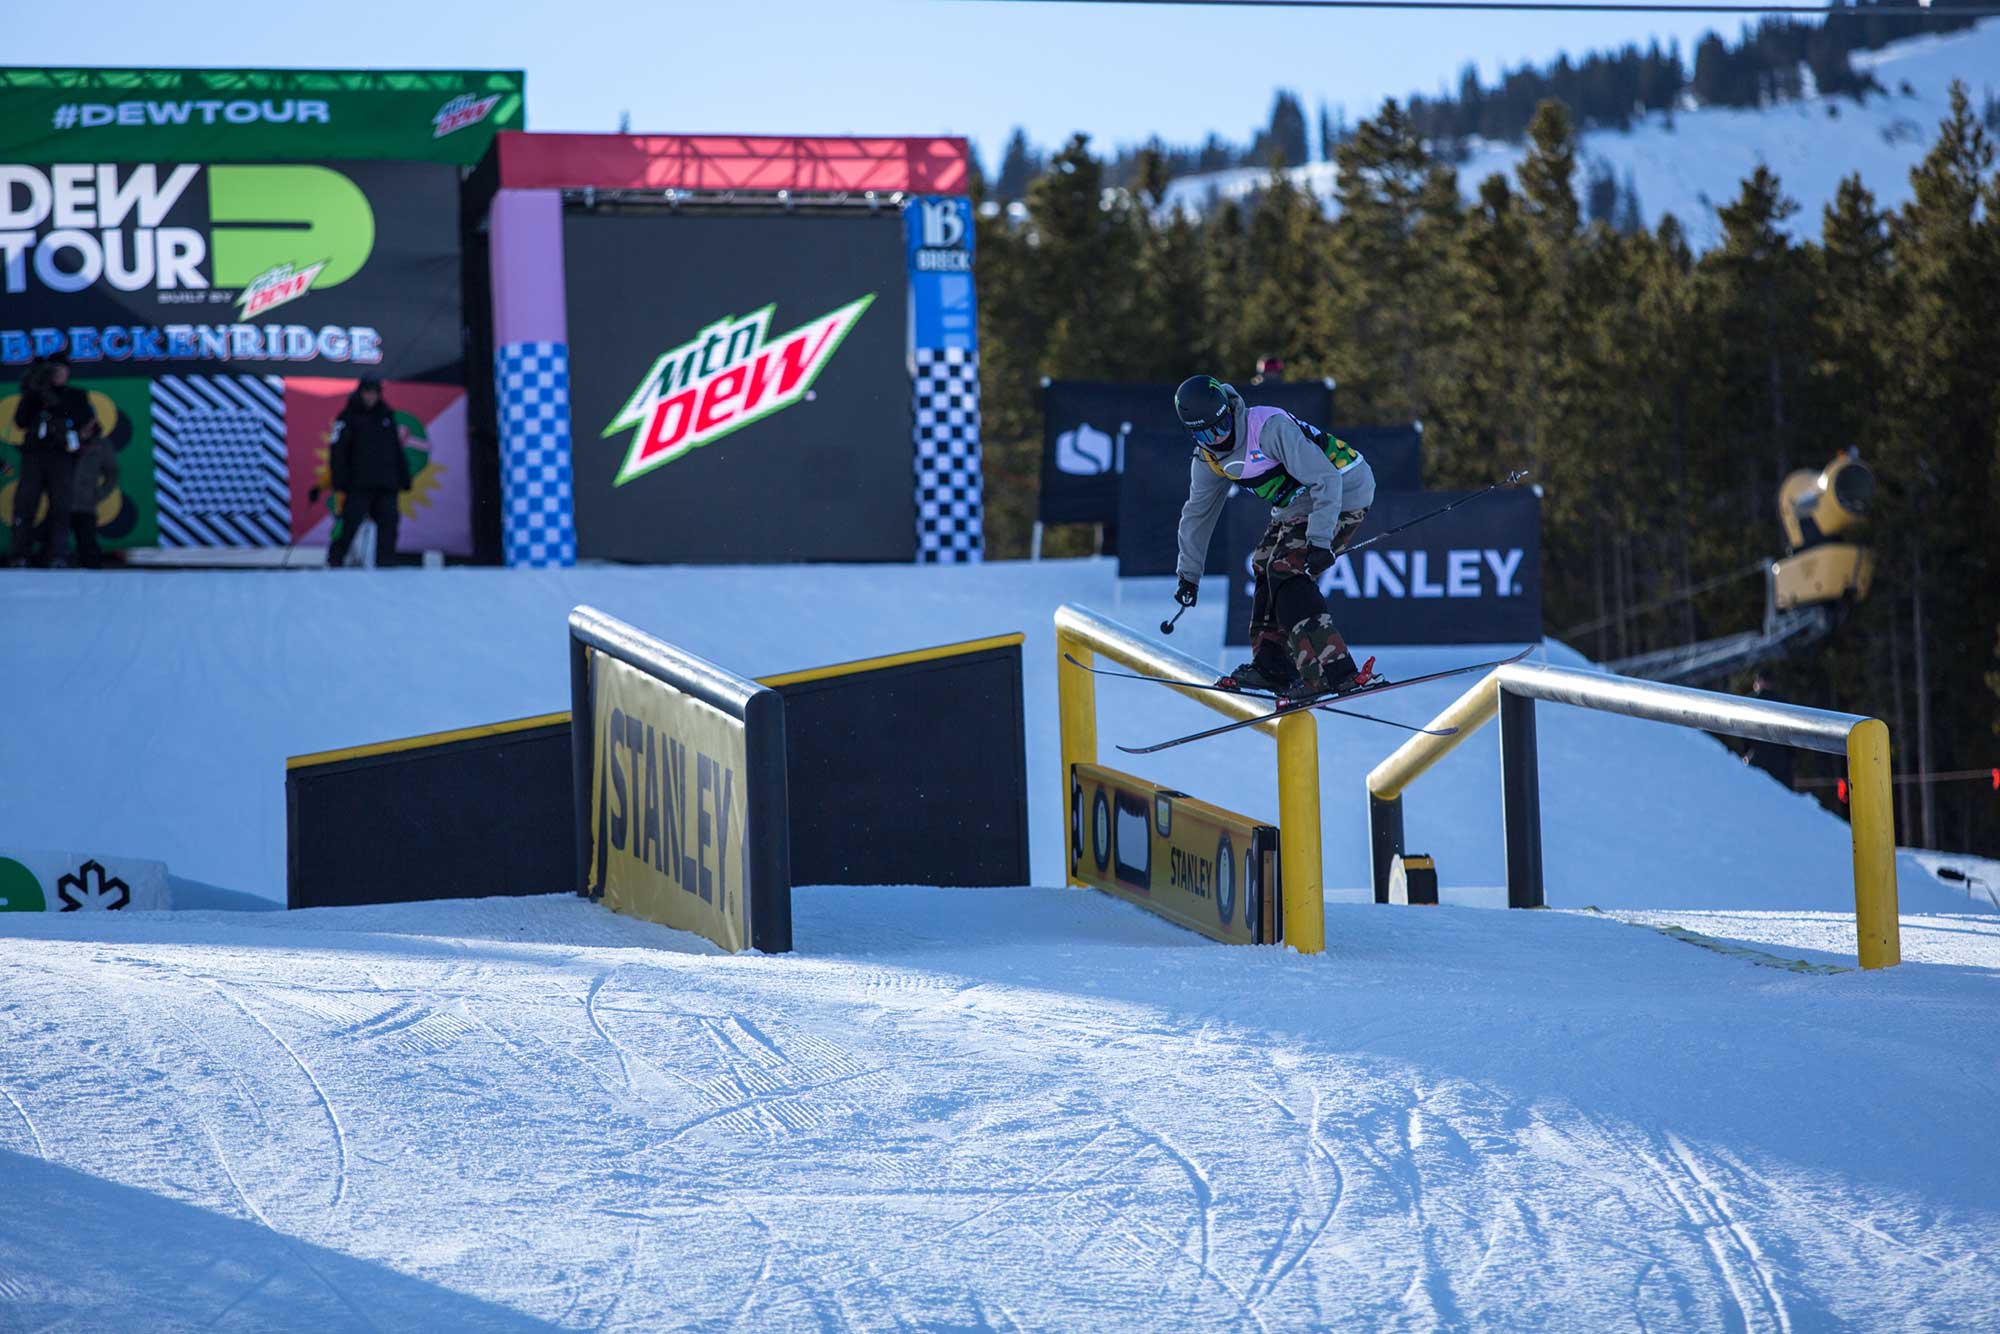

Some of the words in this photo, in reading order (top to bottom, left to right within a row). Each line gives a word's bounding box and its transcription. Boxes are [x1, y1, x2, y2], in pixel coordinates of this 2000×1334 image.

[53, 99, 330, 130] #DEWTOUR
[0, 164, 201, 230] DEW
[0, 229, 210, 294] TOUR
[916, 250, 970, 271] BRECK
[0, 324, 383, 365] BRECKENRIDGE
[1245, 549, 1524, 598] ANLEY
[610, 707, 733, 913] STANLEY
[1171, 846, 1213, 900] STANLEY
